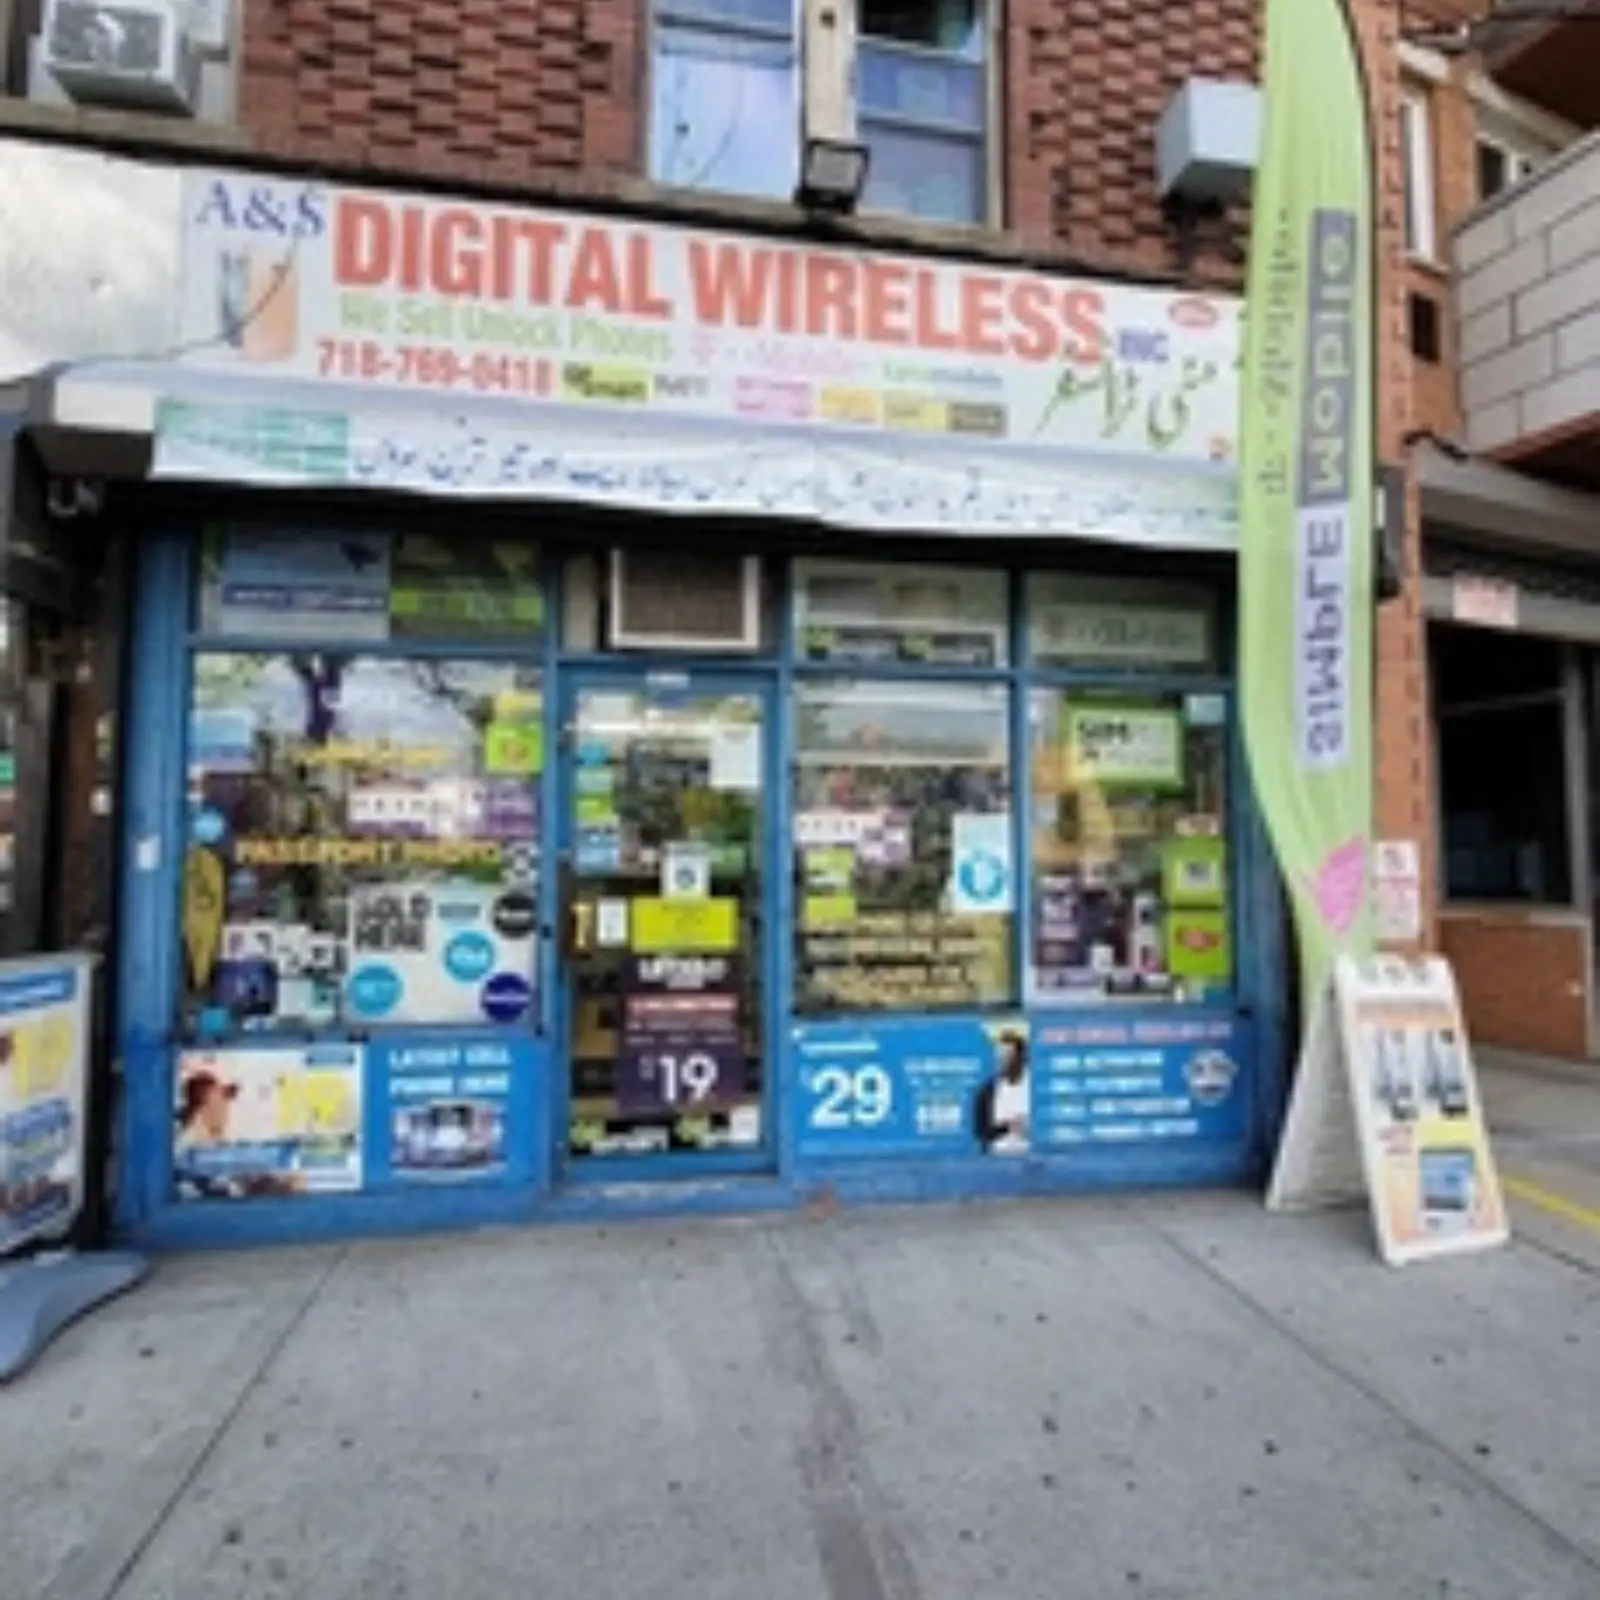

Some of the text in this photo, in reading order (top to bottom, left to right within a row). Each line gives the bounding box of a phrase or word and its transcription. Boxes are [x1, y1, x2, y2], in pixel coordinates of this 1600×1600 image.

[195, 180, 325, 237] A&S
[333, 196, 672, 318] DIGITAL
[689, 241, 1104, 364] WIRELESS
[316, 339, 554, 397] 718-769-0418
[658, 1051, 719, 1103] 19
[811, 1063, 893, 1129] 29
